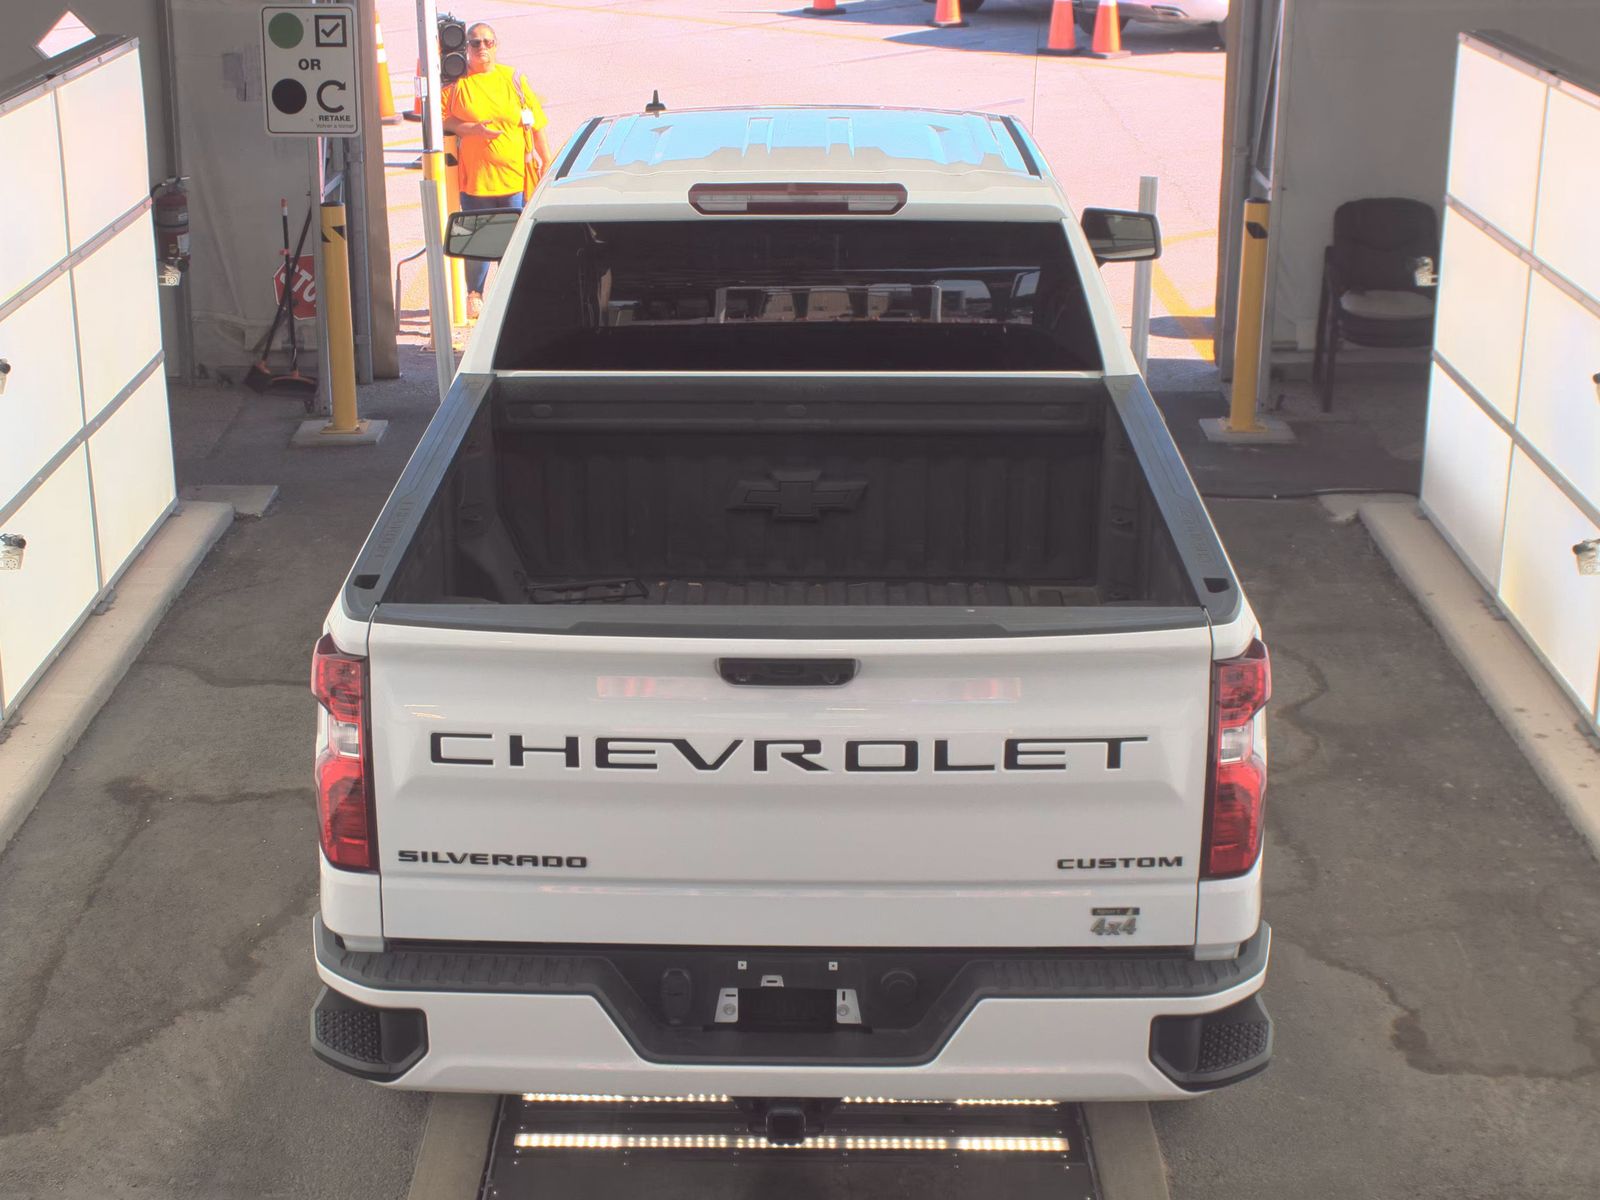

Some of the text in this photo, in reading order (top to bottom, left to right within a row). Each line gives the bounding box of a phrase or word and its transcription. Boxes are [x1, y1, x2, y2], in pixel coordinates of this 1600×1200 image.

[298, 58, 321, 70] OR
[431, 732, 1148, 772] CHEVROLET
[398, 850, 588, 868] SILVERADO
[1056, 856, 1183, 869] CUSTOM
[1090, 917, 1137, 935] 4x4
